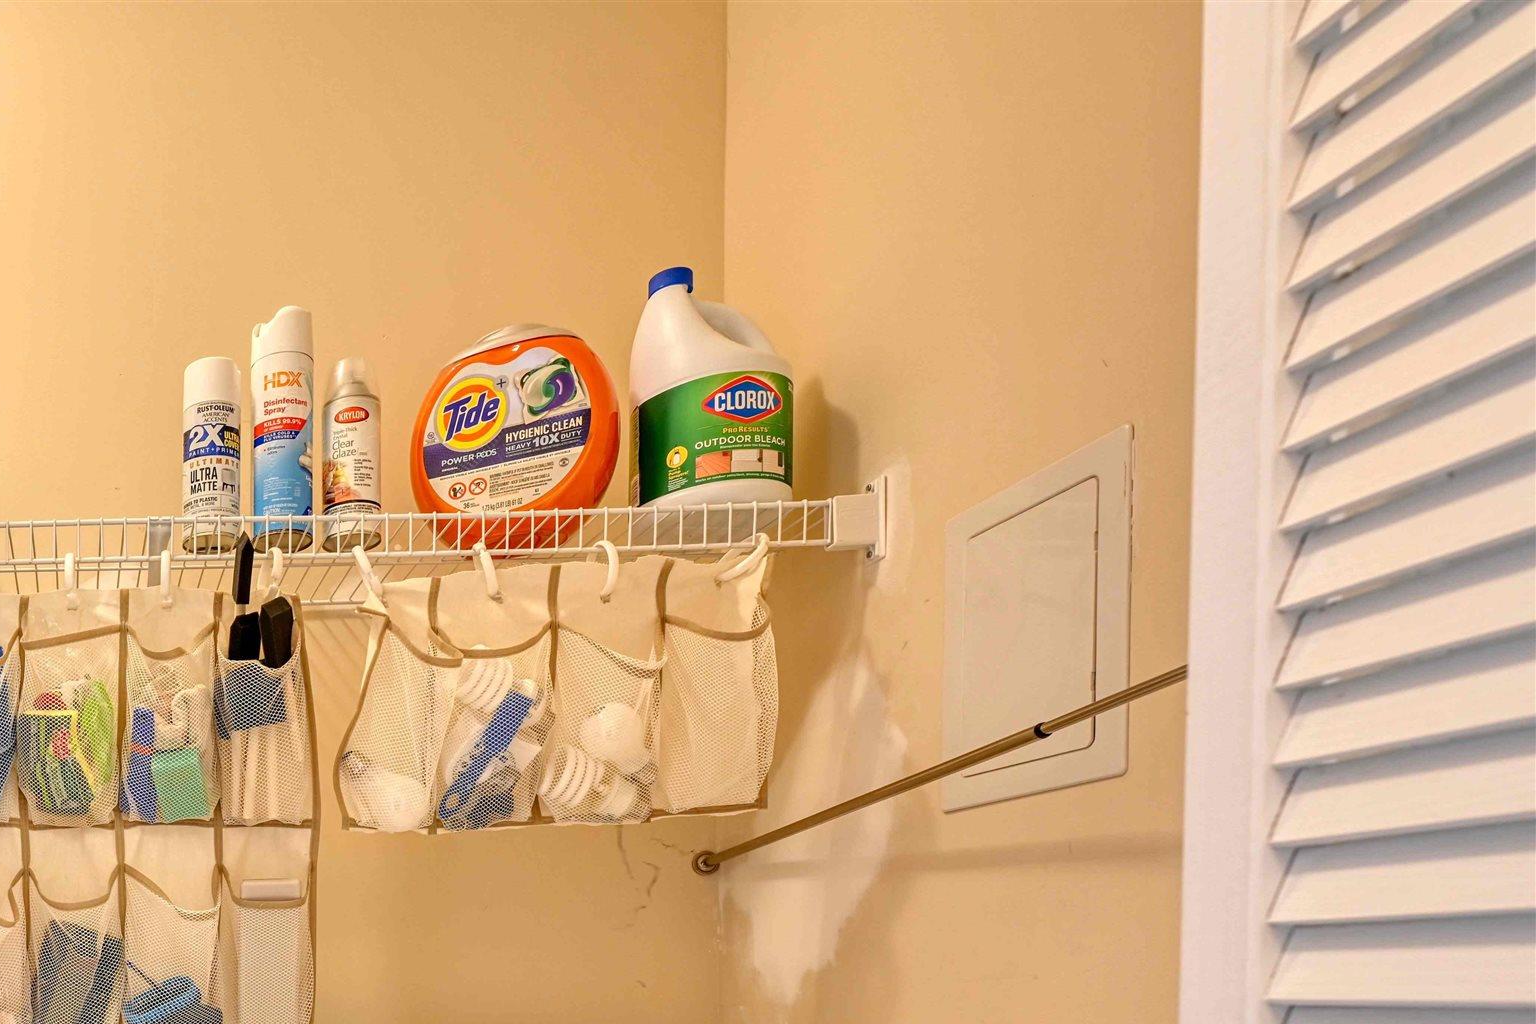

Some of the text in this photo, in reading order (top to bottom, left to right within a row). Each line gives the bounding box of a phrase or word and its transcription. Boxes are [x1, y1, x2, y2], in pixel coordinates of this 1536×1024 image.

[264, 371, 302, 391] HDX
[264, 397, 308, 409] Disinfectant
[714, 391, 775, 412] CLOROX
[264, 406, 286, 416] Spray
[339, 410, 365, 421] KRYLON
[443, 391, 500, 443] Tide
[264, 420, 281, 428] KILLS
[505, 415, 583, 444] HYGIENIC CLEAN
[189, 423, 225, 452] 2X
[332, 439, 354, 451] Clear
[505, 429, 582, 454] HEAVY 10X DUTY
[695, 434, 786, 450] OUTDOOR BLEACH
[189, 448, 210, 459] PAINT
[332, 448, 357, 460] Glaze
[191, 467, 218, 484] ULTRA
[191, 481, 218, 495] MATTE
